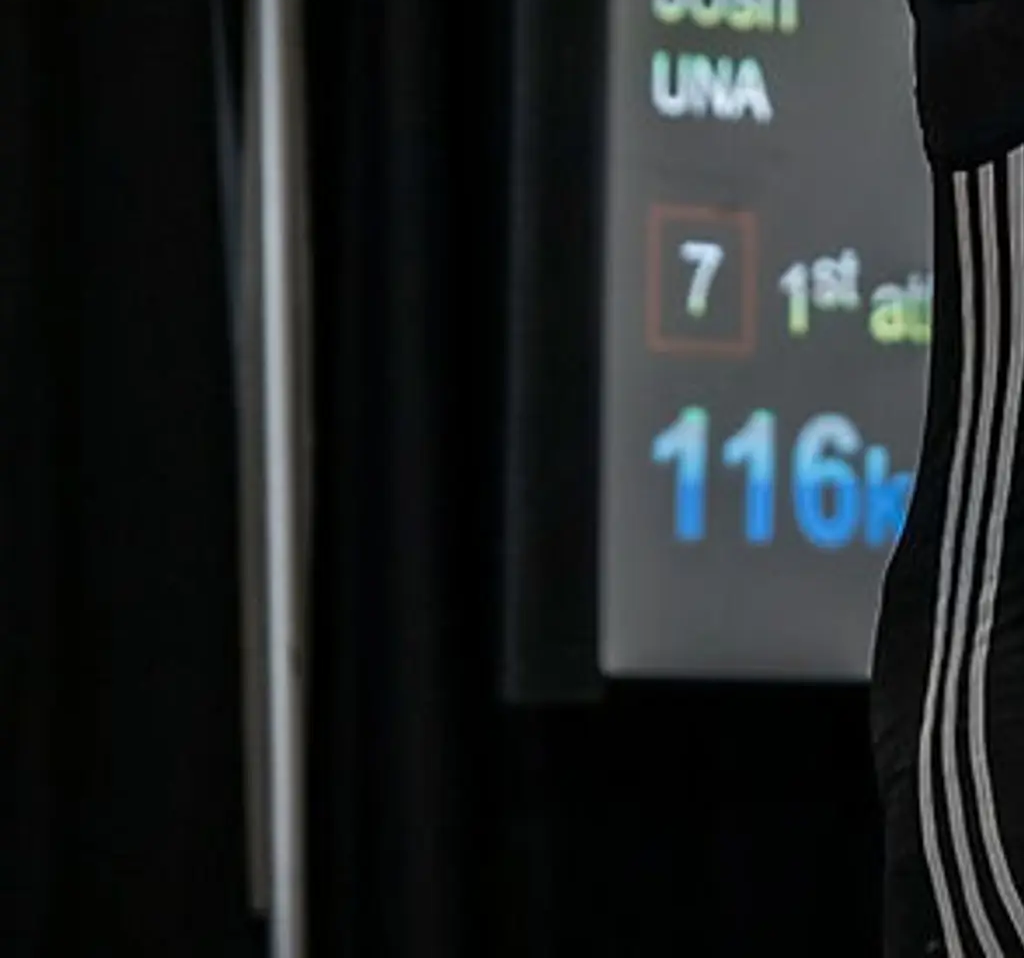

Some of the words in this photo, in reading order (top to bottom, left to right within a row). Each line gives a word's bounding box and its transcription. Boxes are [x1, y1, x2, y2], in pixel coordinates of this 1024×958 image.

[651, 49, 774, 125] UNA
[679, 240, 725, 318] 7
[778, 246, 861, 339] 1st
